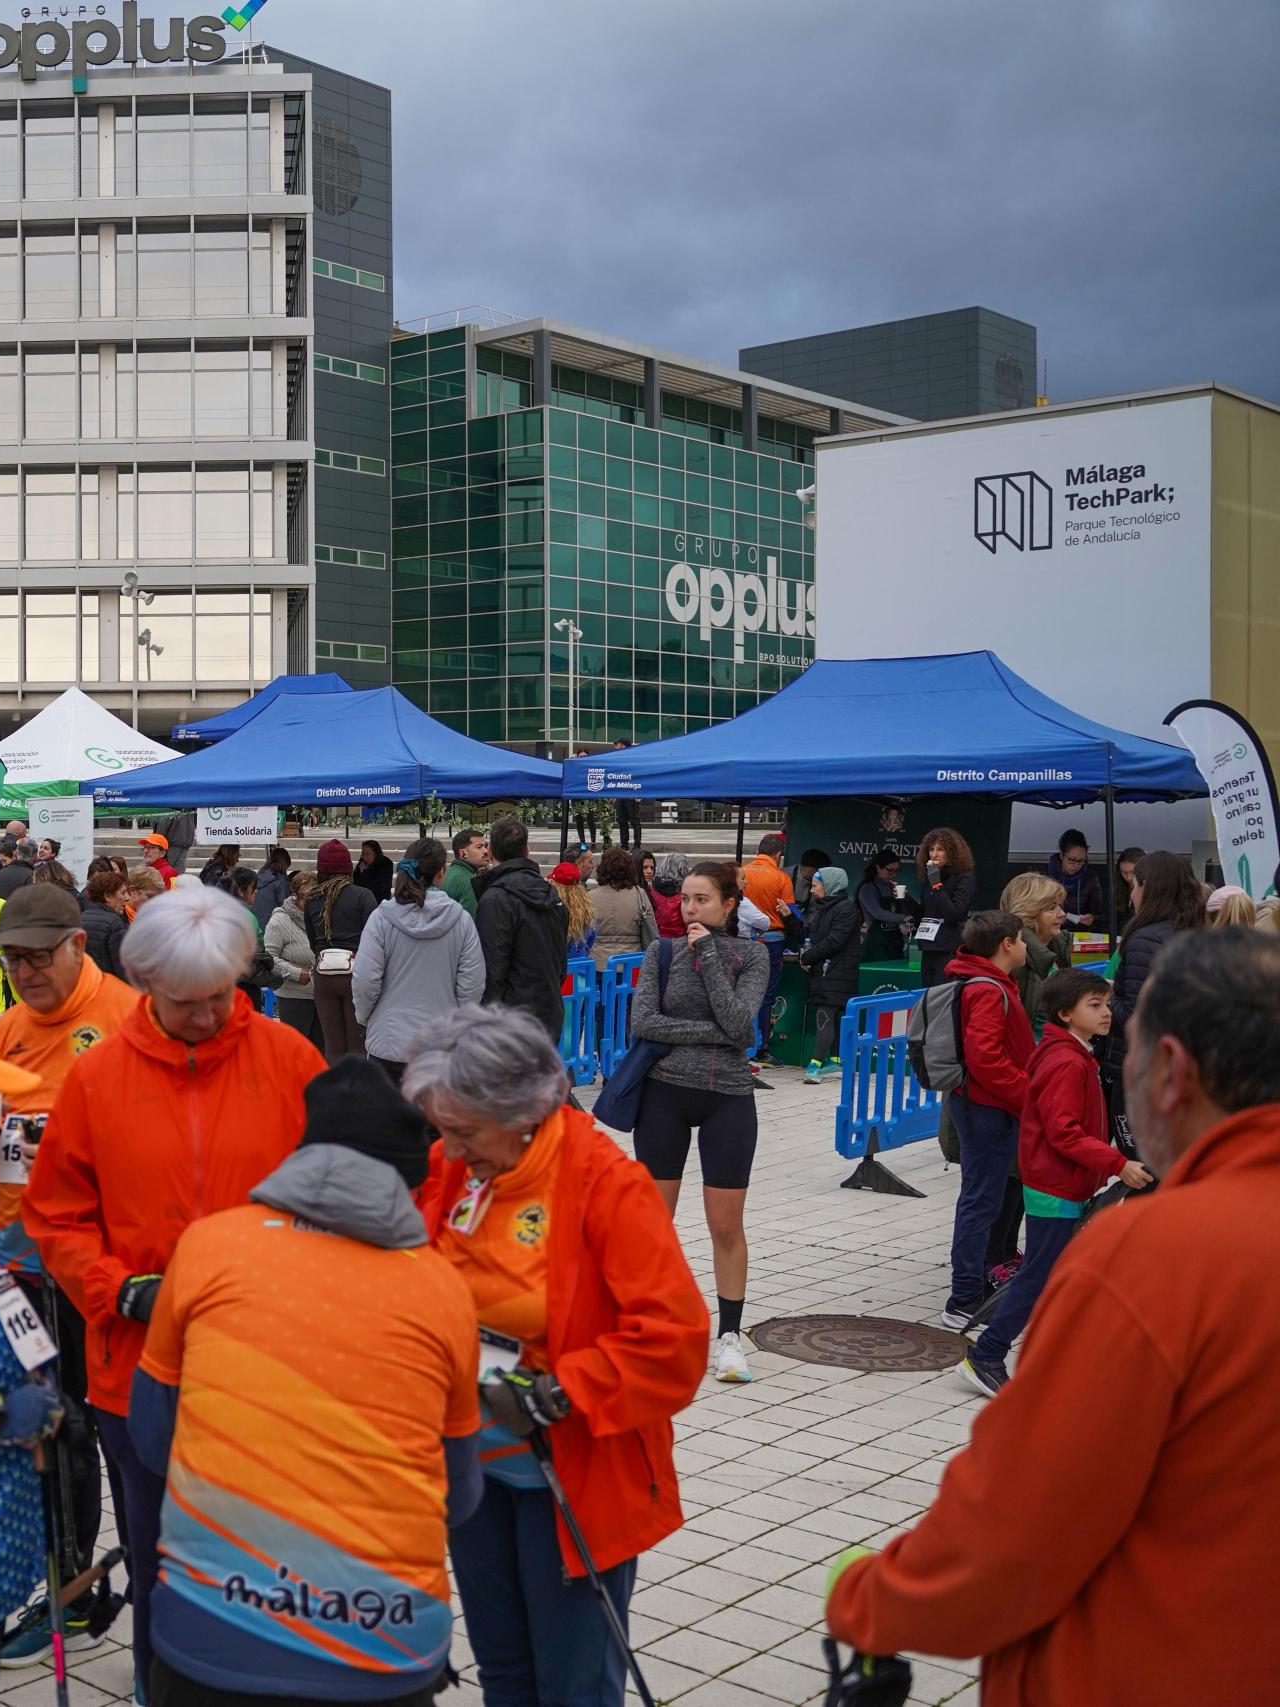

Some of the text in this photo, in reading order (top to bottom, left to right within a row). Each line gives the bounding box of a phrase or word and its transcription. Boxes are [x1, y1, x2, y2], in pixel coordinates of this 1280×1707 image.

[21, 5, 106, 18] GRUPO
[1066, 464, 1146, 486] Málaga
[1065, 484, 1174, 512] TechPark;
[1065, 511, 1180, 532] Parque Tecnológico
[1065, 529, 1141, 546] de Andalucía
[675, 534, 758, 564] GRUPO
[760, 652, 774, 662] BPO
[937, 768, 1072, 783] Distrito Campanillas
[316, 784, 400, 797] Distrito Campanillas
[617, 782, 642, 790] Málaga
[205, 827, 272, 836] Tienda Solidaria
[839, 841, 878, 855] SANTA
